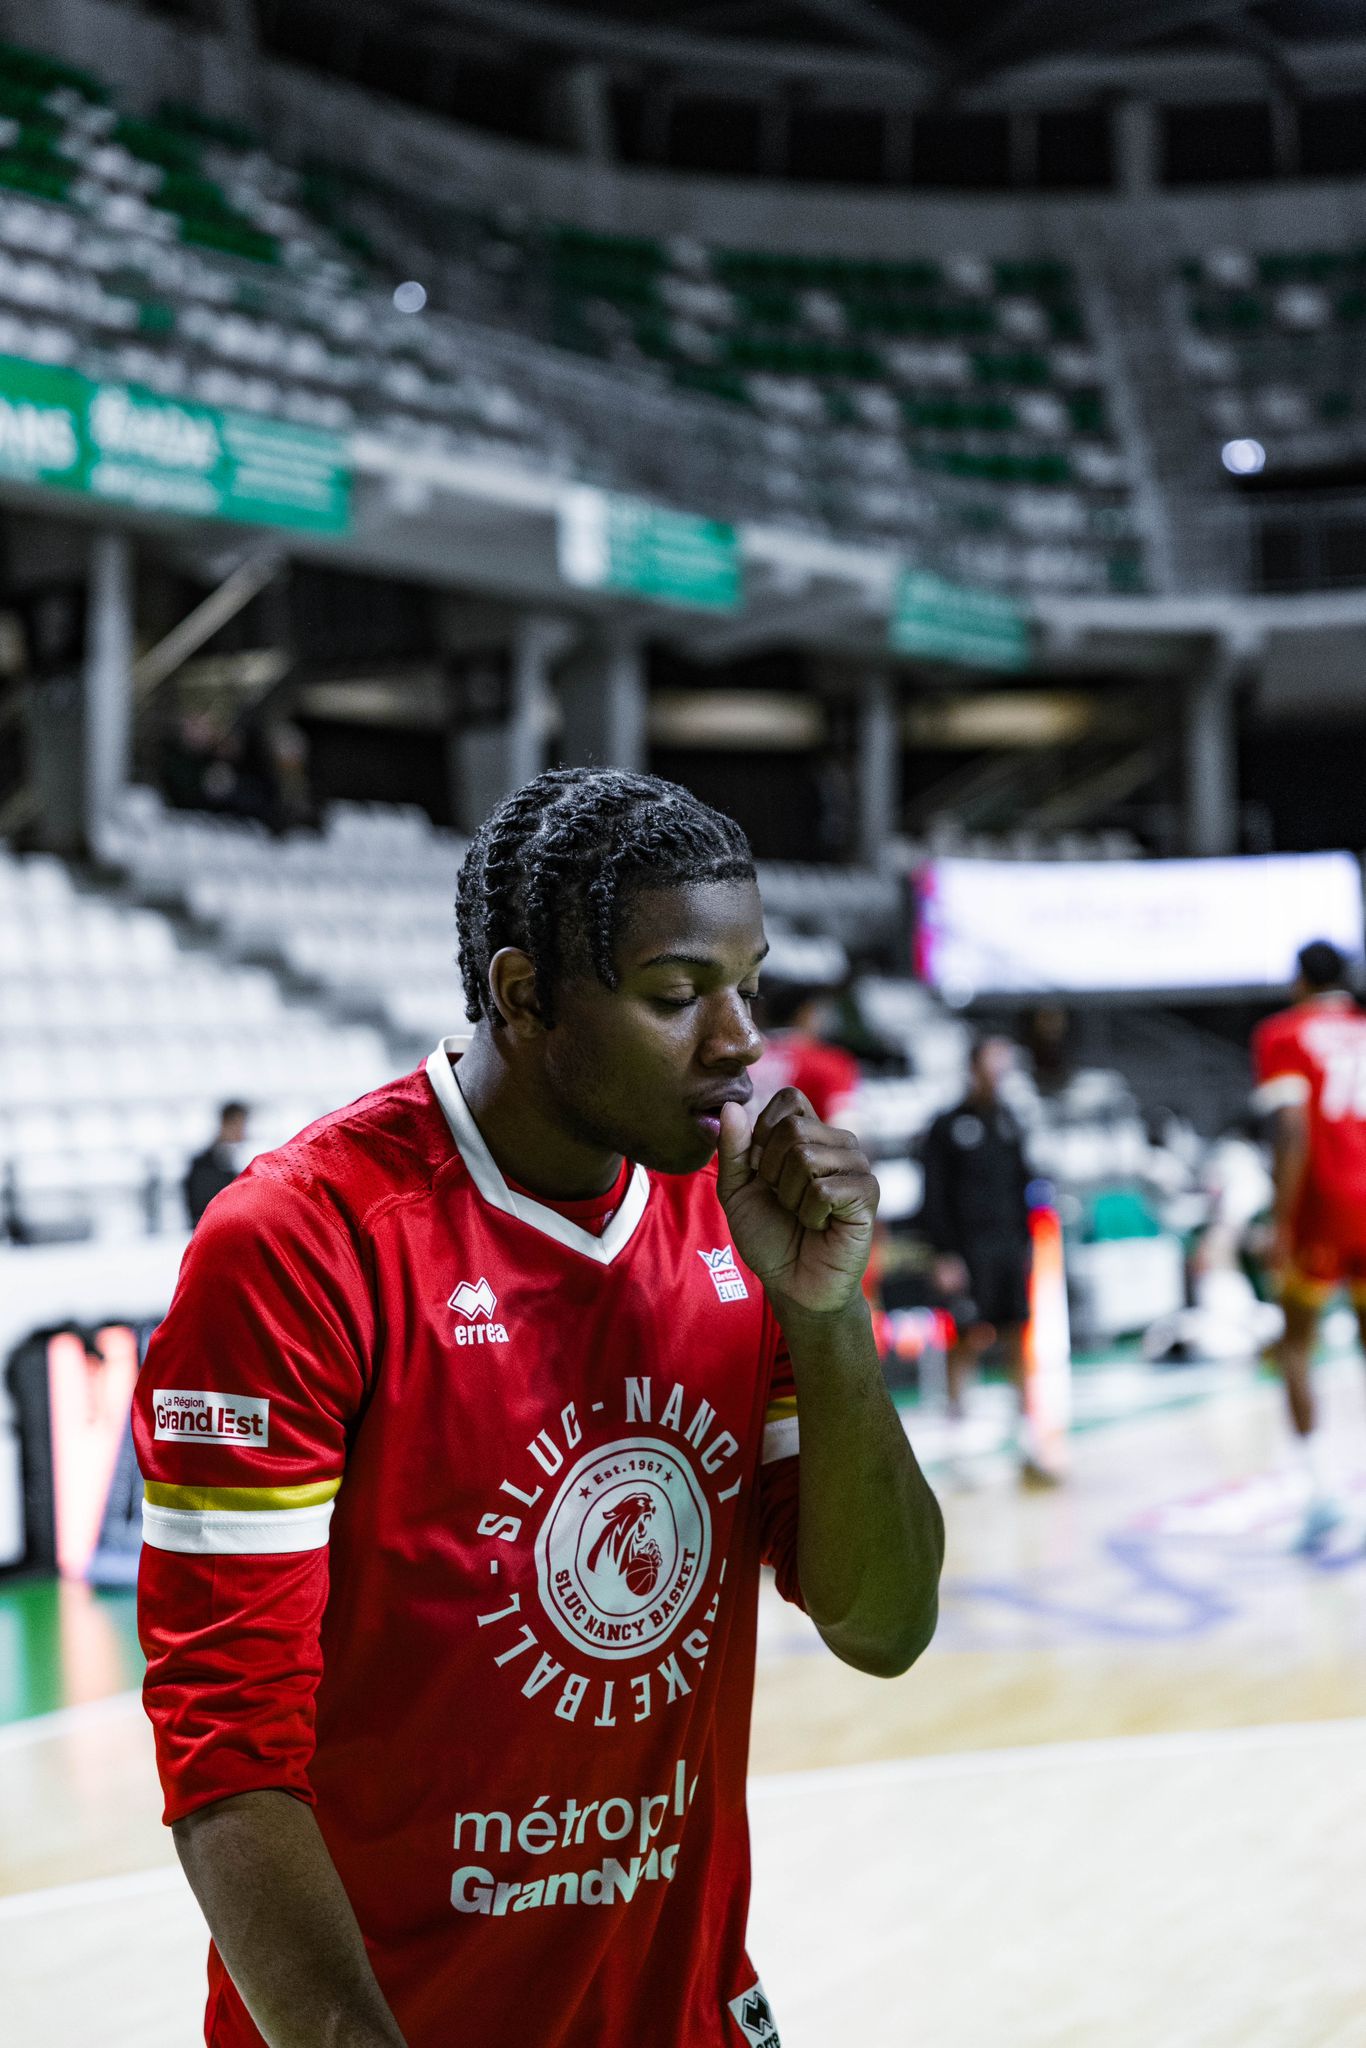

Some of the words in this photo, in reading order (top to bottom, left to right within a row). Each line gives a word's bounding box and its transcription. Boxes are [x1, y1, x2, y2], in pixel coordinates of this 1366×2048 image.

[454, 1322, 510, 1346] errea
[163, 1396, 173, 1407] La
[173, 1396, 205, 1409] Région
[157, 1405, 213, 1432] Grand
[218, 1408, 263, 1436] Est
[476, 1401, 583, 1543] SLUC
[555, 1568, 588, 1622] SLUC
[584, 1614, 646, 1642] NANCY
[648, 1547, 696, 1629] BASKET
